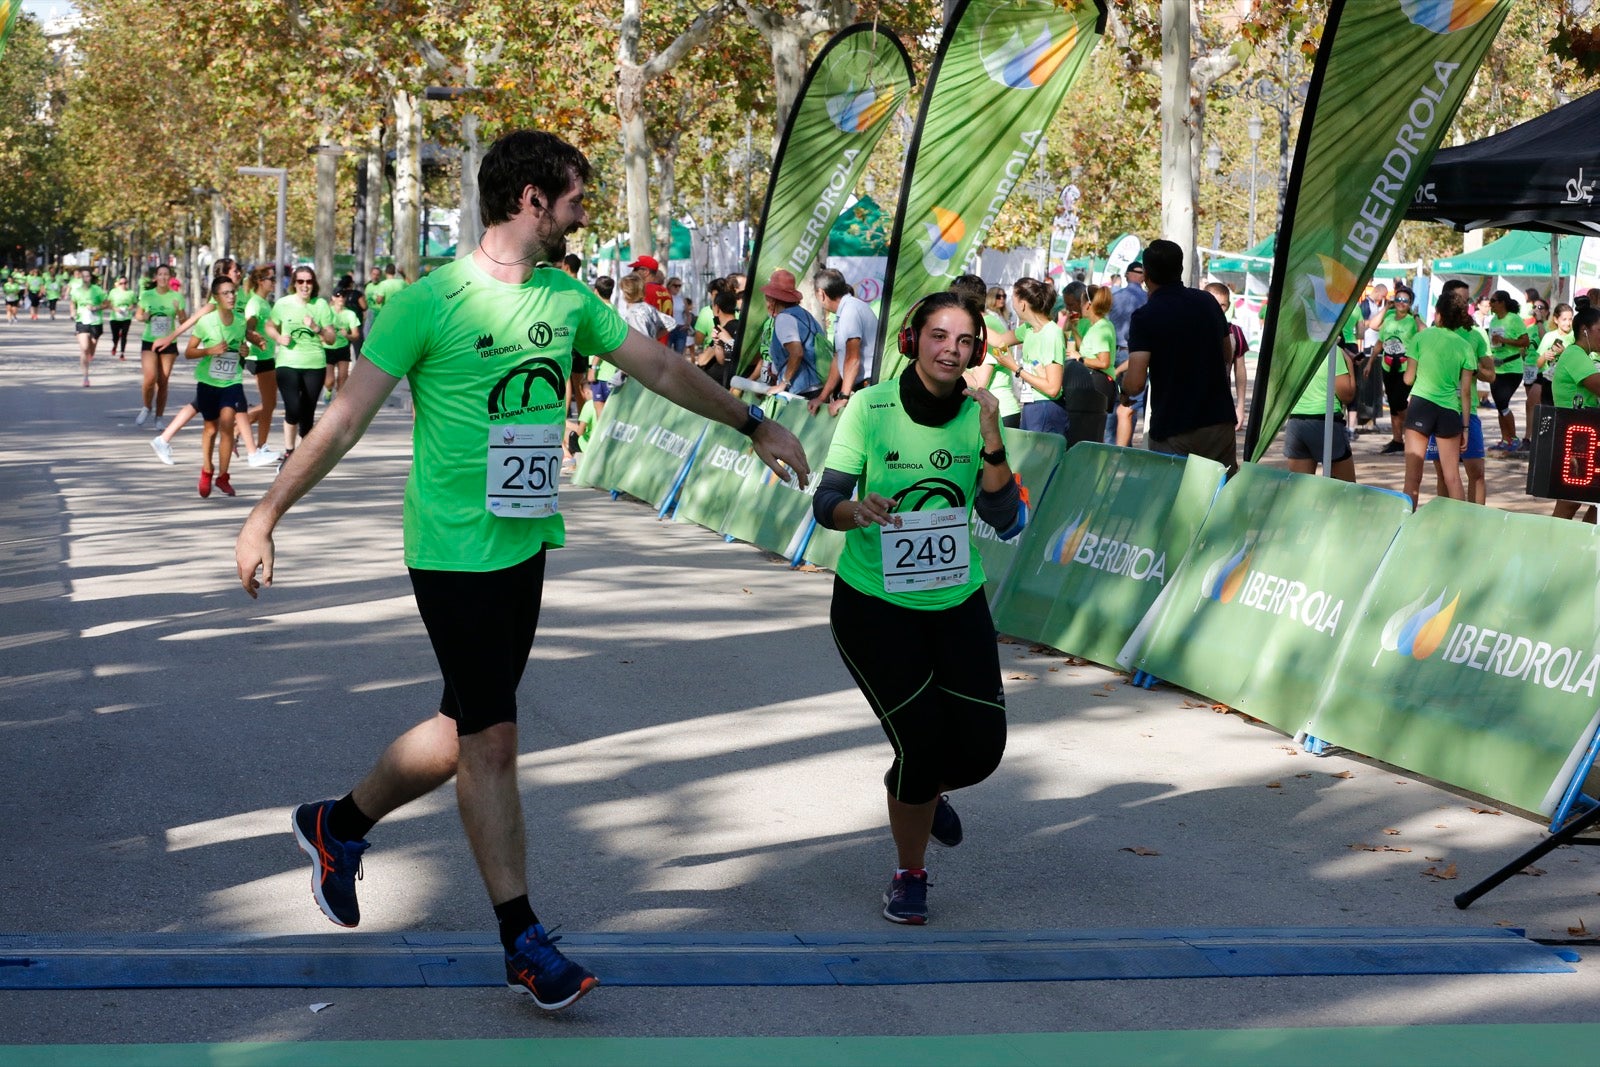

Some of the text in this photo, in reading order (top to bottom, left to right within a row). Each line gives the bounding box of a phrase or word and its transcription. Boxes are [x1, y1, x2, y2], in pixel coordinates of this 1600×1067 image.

[1342, 60, 1461, 264] IBERDROLA
[788, 148, 861, 273] IBERDROLA
[445, 285, 465, 300] luanvi
[480, 343, 524, 359] IBERDROLA
[214, 359, 237, 372] 307
[869, 402, 889, 410] luanvi
[489, 414, 500, 422] EN
[501, 409, 525, 419] FORMA
[501, 455, 559, 491] 250
[887, 462, 924, 470] IBERDROLA
[895, 534, 957, 569] 249
[1441, 622, 1600, 698] IBERDROLA
